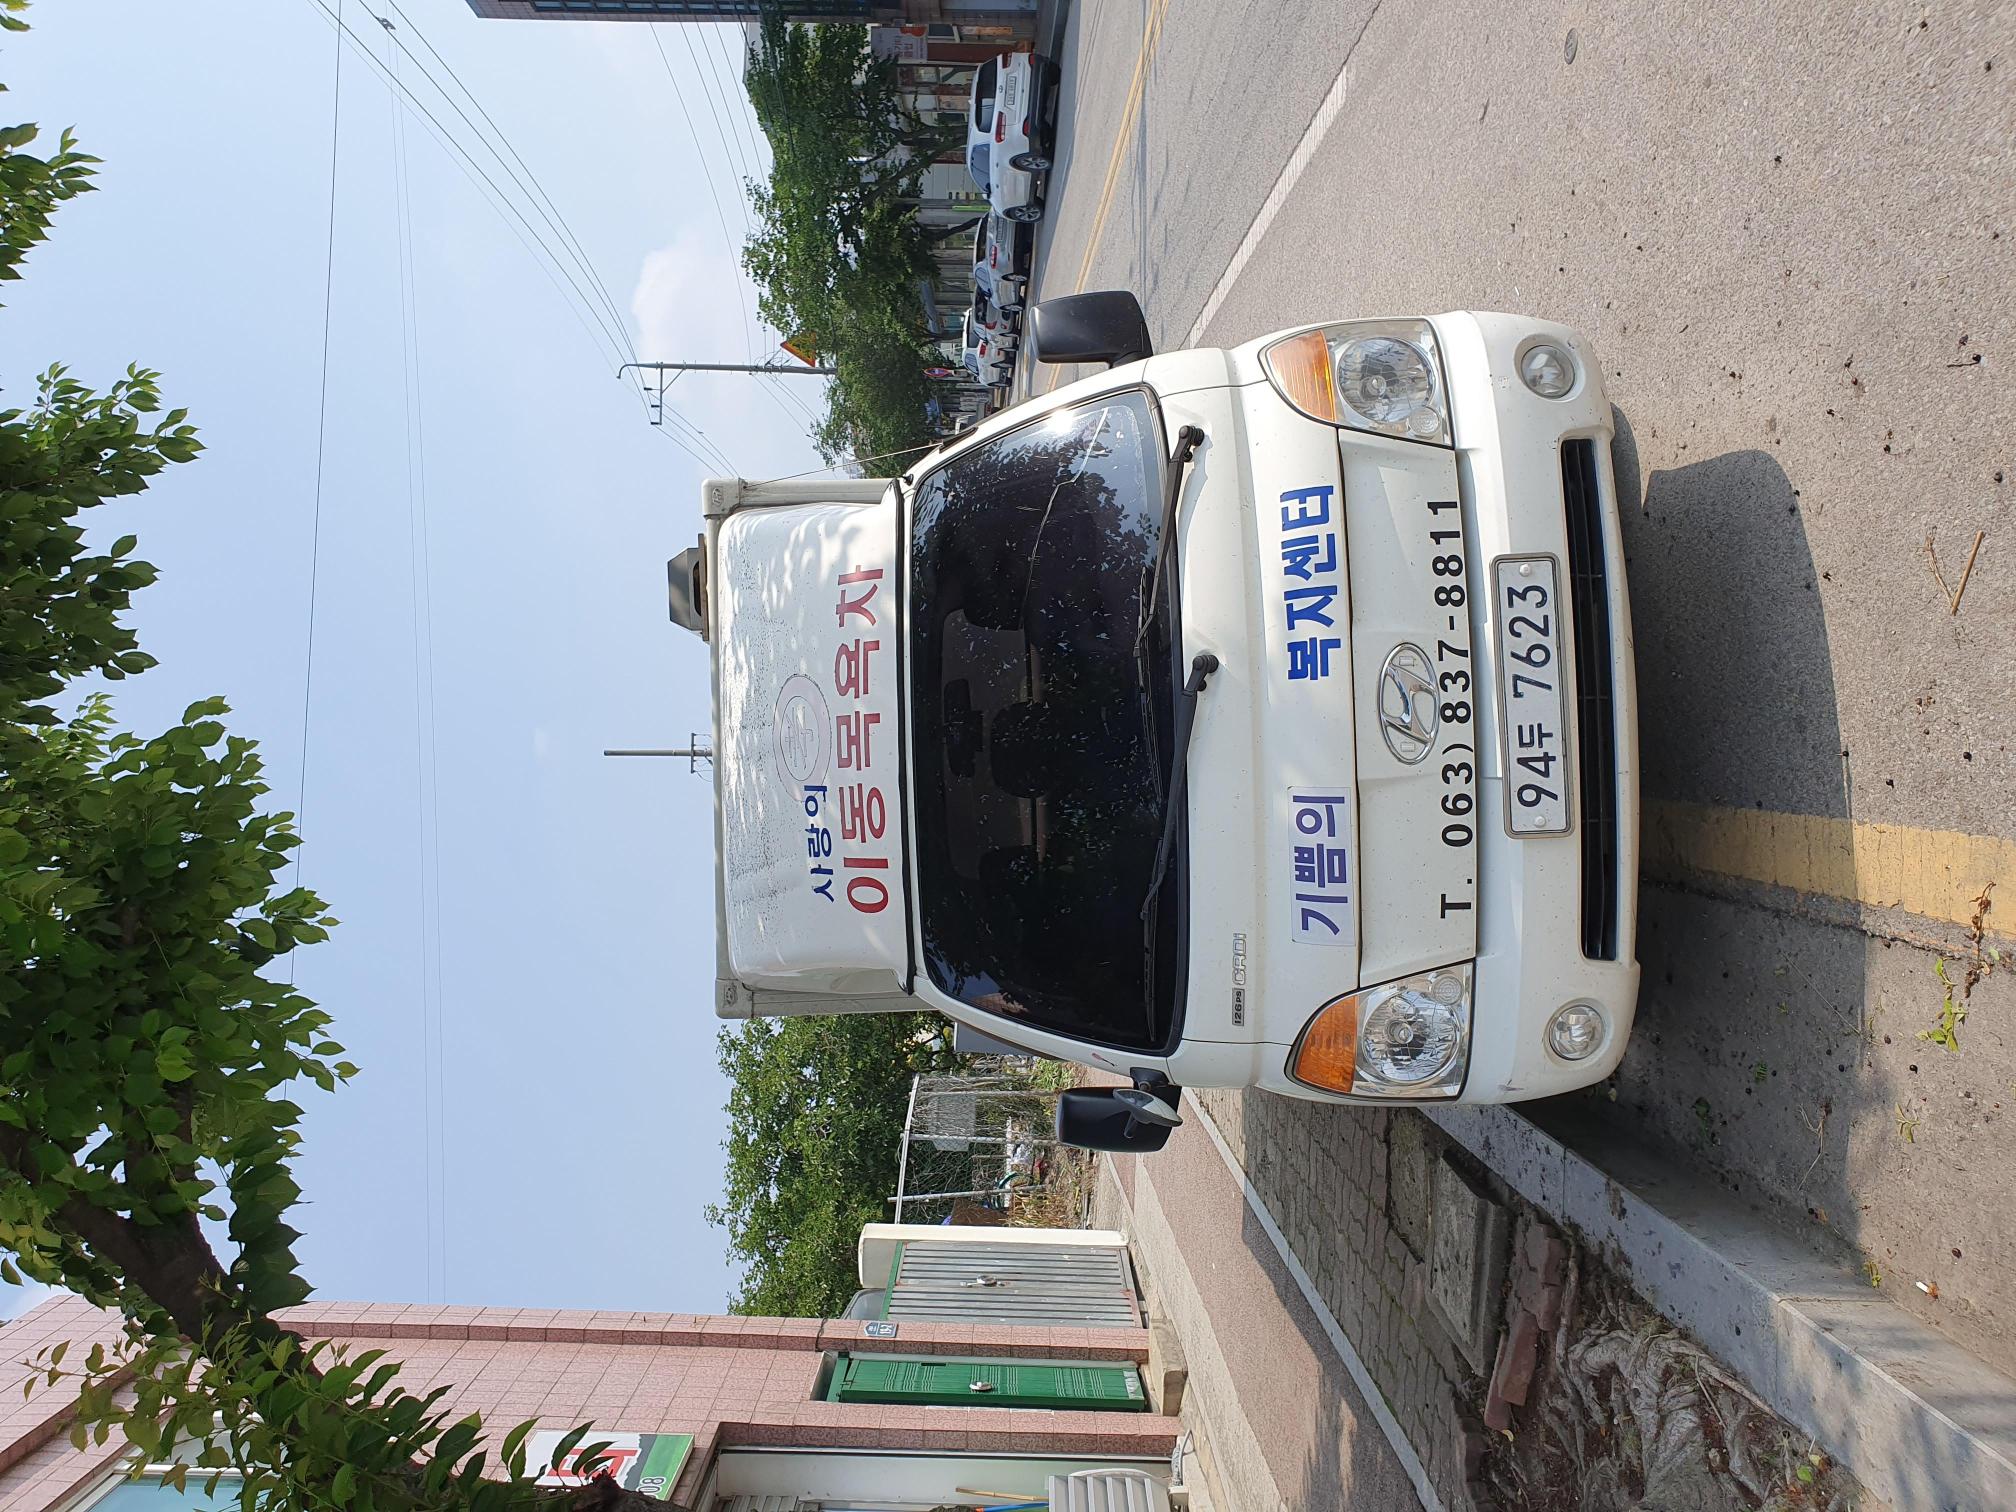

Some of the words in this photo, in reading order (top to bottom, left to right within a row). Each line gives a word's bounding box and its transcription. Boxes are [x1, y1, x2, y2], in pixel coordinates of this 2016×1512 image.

[1280, 485, 1341, 681] 복지센터
[1506, 584, 1553, 699] 7623
[835, 564, 889, 914] 이동목욕차
[1516, 723, 1559, 808] 94두
[803, 784, 835, 903] 사랑의
[1292, 795, 1348, 936] 기쁨의
[1232, 932, 1247, 986] CRDi
